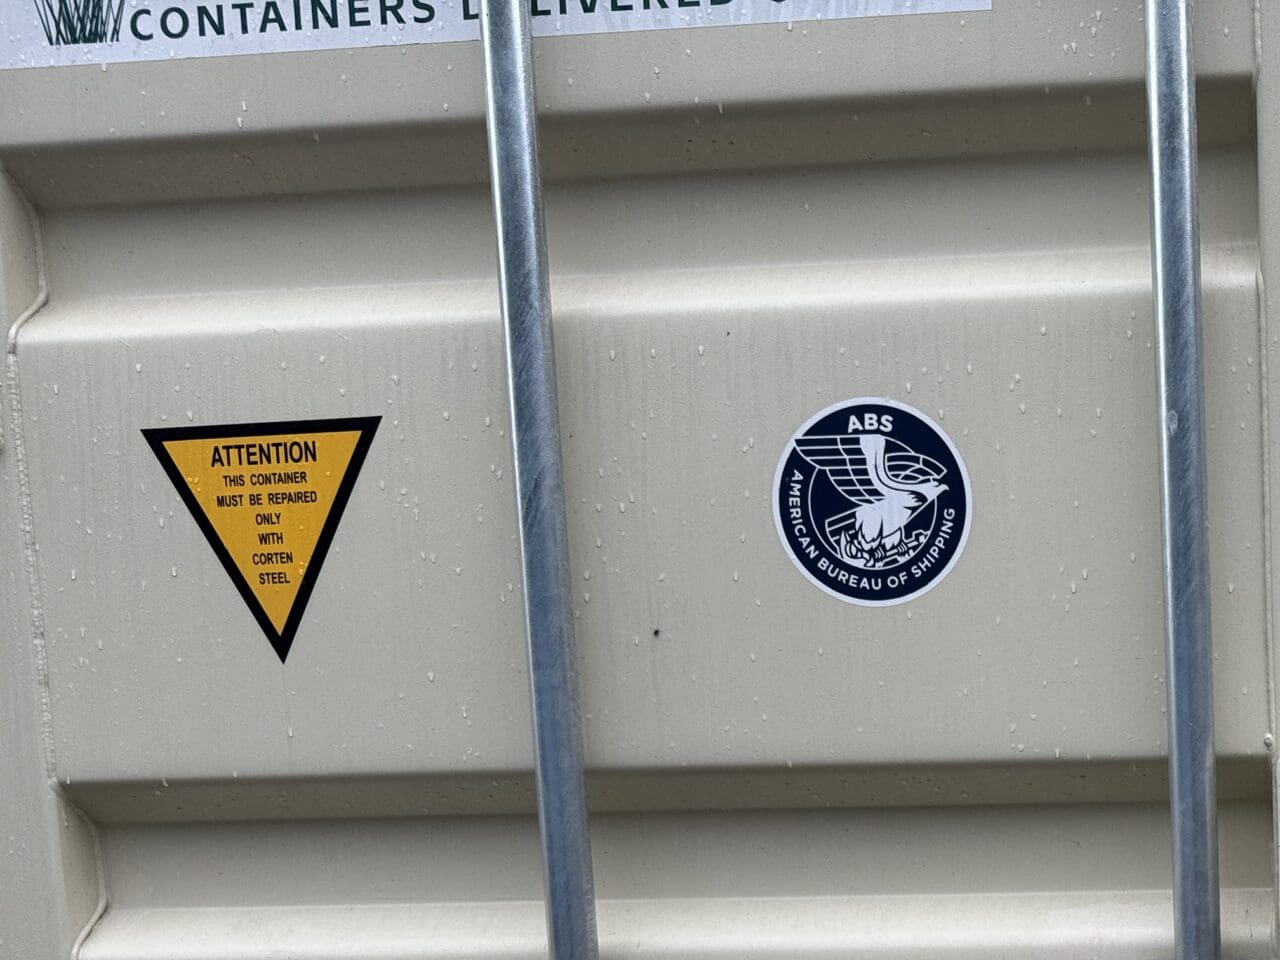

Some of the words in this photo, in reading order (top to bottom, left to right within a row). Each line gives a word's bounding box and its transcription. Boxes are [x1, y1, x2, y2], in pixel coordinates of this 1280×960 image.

[130, 0, 436, 41] CONTAINERS
[848, 413, 894, 433] ABS
[210, 441, 317, 467] ATTENTION
[223, 474, 245, 487] THIS
[250, 471, 307, 486] CONTAINER
[217, 494, 244, 507] MUST
[250, 494, 263, 506] BE
[268, 491, 318, 505] REPAIRED
[255, 512, 281, 526] ONLY
[788, 469, 819, 560] AMERICAN
[817, 558, 882, 591] BUREAU
[887, 572, 909, 588] OF
[911, 507, 956, 578] SHIPPING
[258, 532, 284, 546] WITH
[252, 552, 293, 566] CORTEN
[259, 572, 290, 585] STEEL
